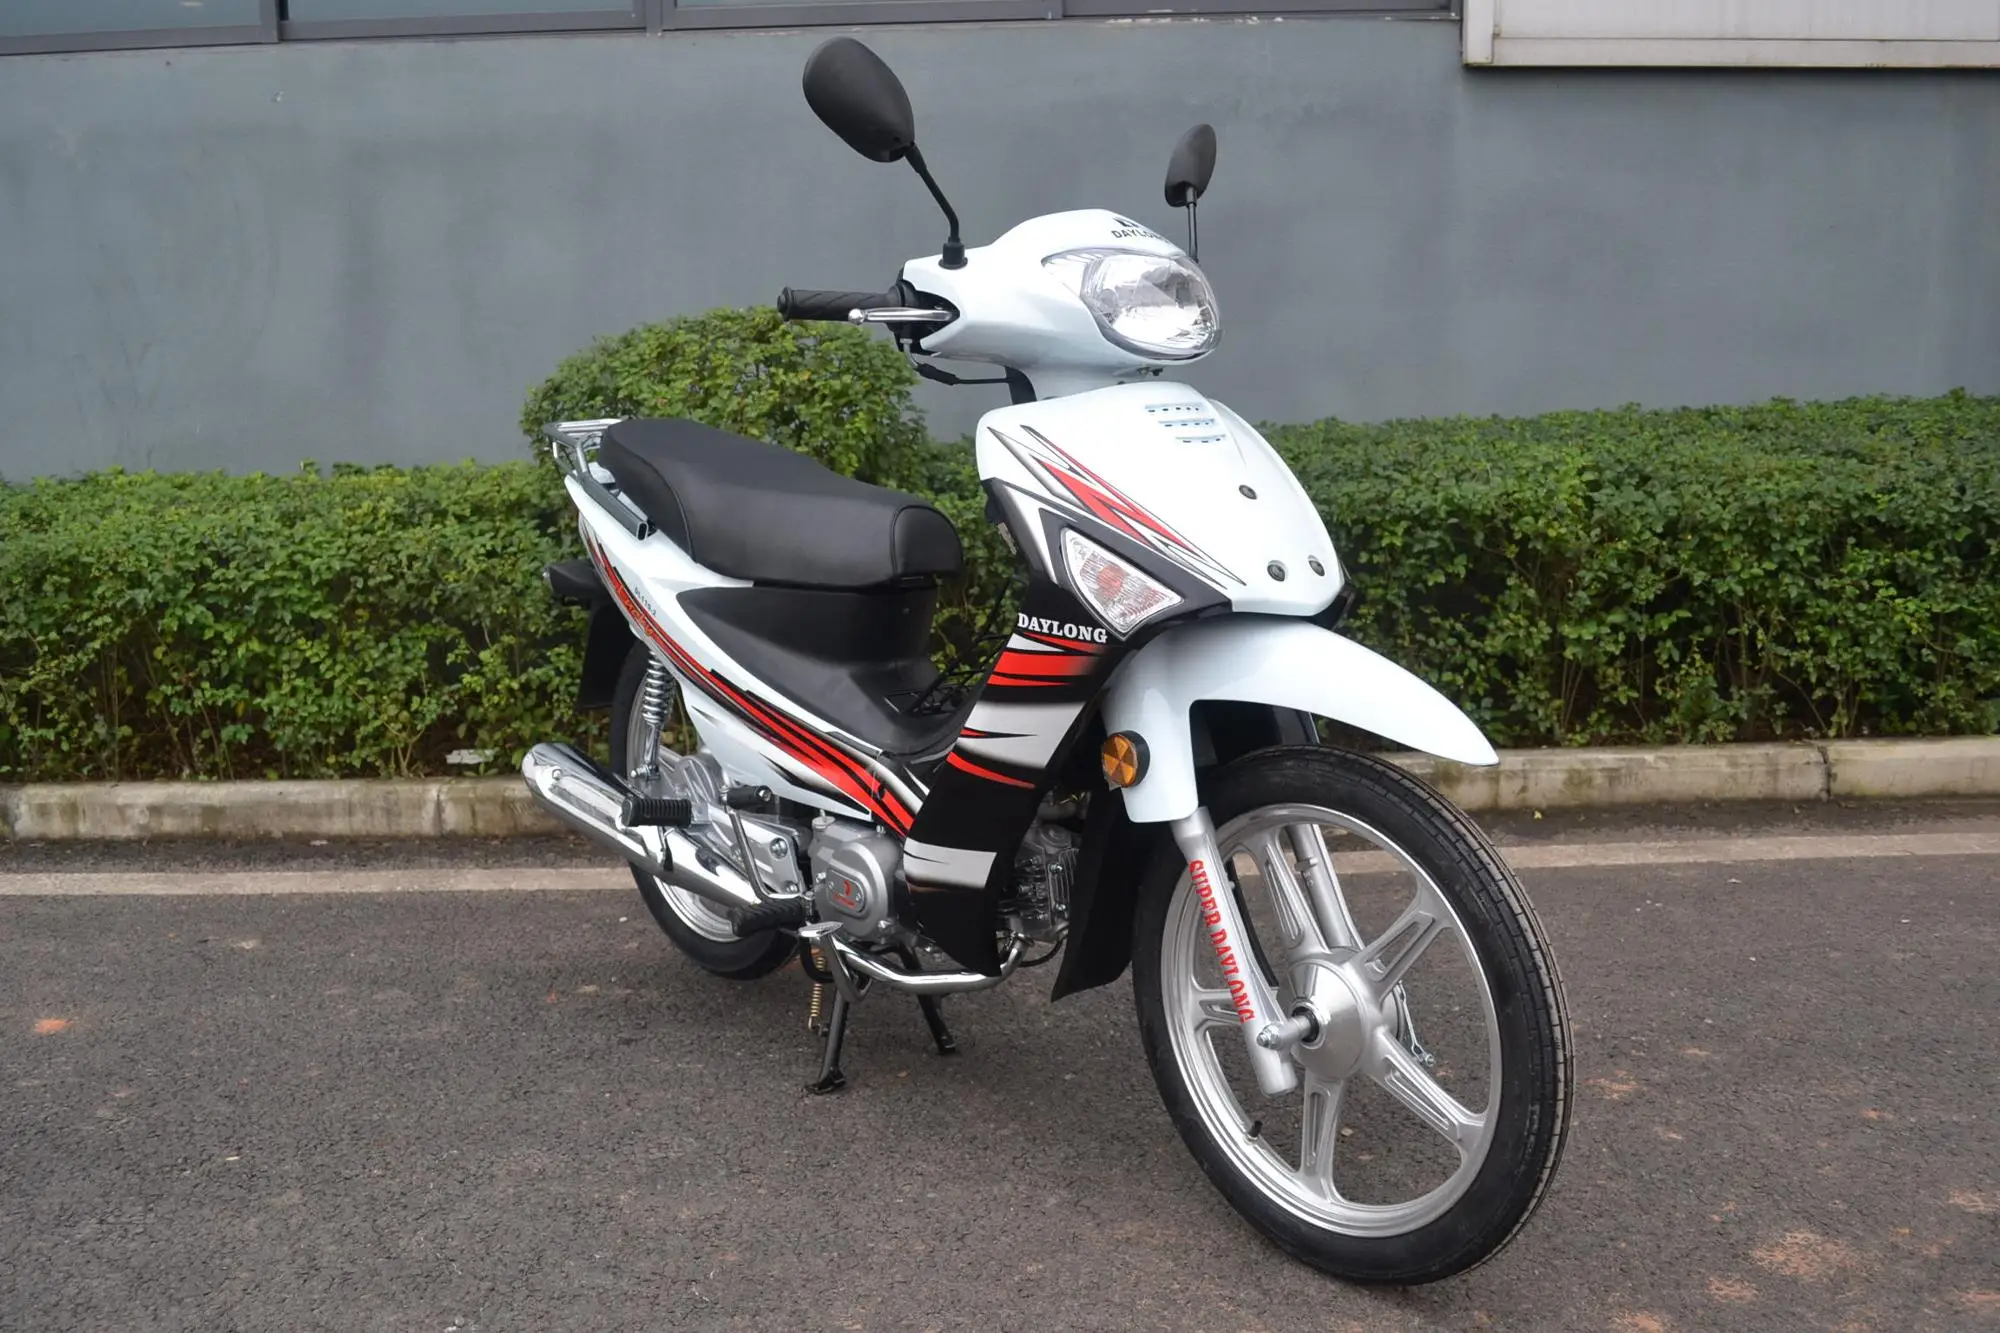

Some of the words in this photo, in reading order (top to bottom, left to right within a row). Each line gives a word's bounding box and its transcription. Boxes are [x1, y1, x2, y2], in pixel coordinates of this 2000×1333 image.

[1017, 612, 1108, 643] DAYLONG
[1188, 859, 1221, 928] SUPER
[1209, 928, 1255, 1024] DAYLONG
